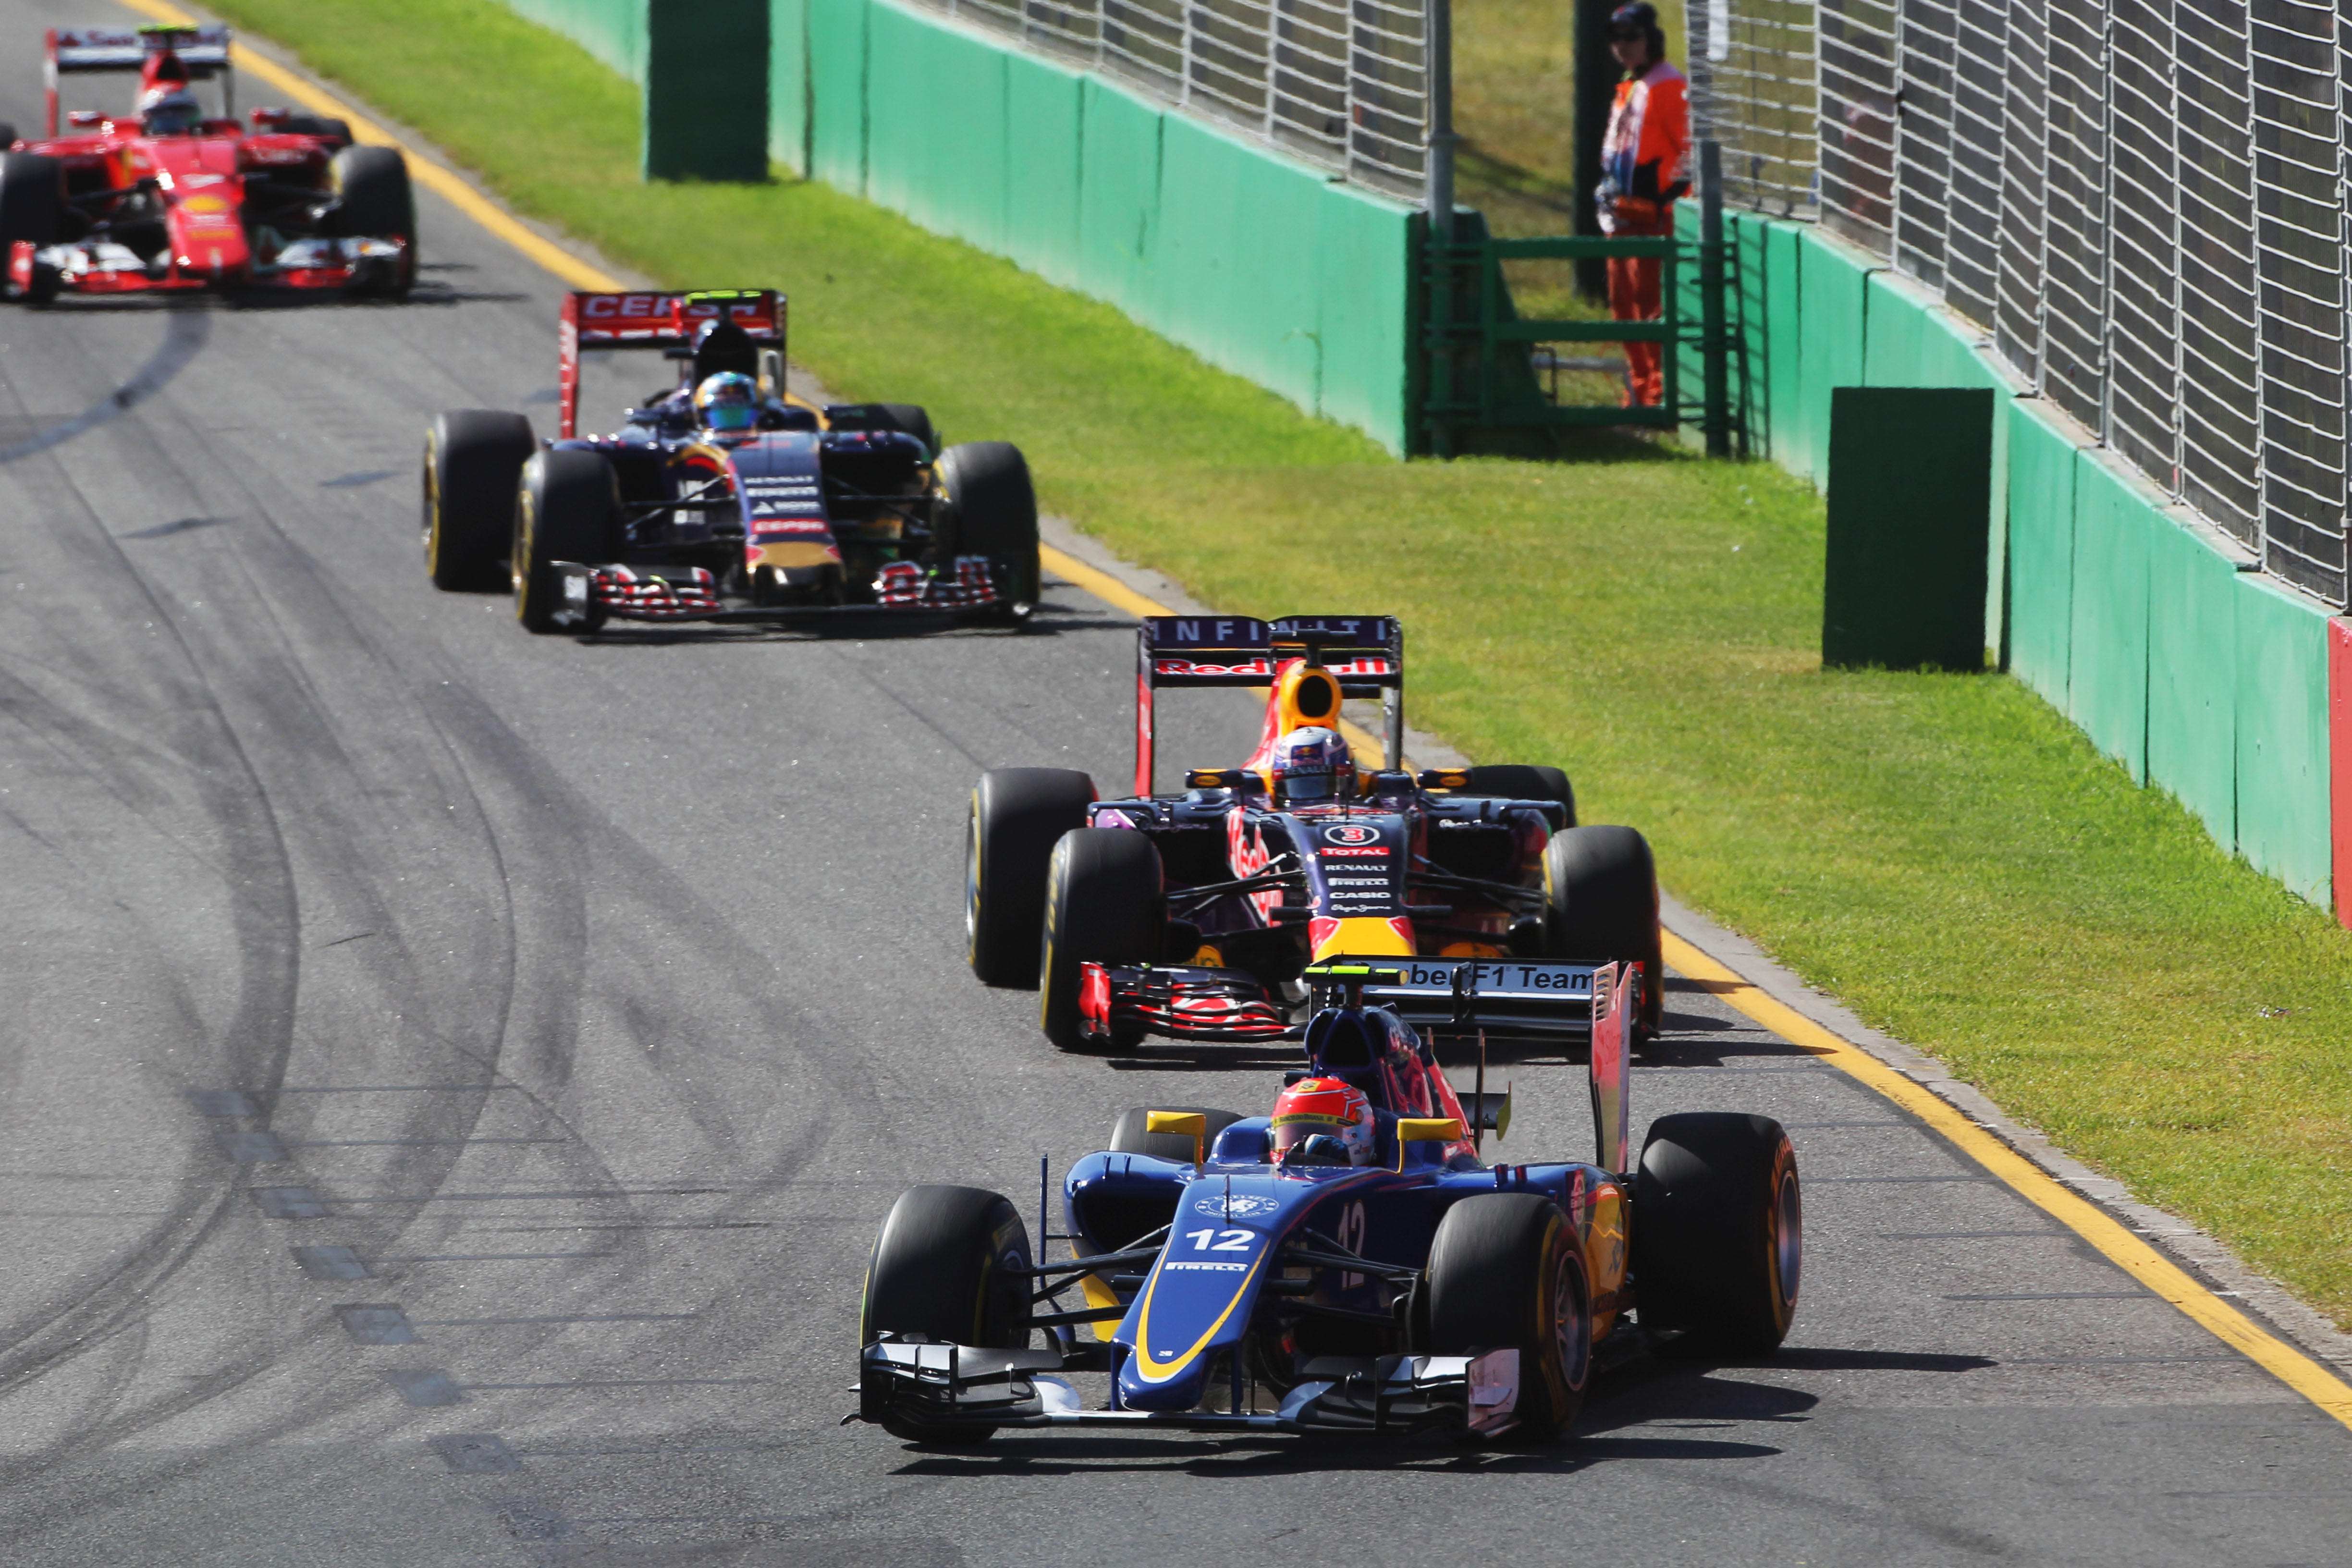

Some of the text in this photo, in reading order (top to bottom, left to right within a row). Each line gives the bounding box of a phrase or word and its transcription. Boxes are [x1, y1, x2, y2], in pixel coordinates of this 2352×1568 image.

[1154, 658, 1271, 675] Red
[1341, 828, 1365, 841] 3
[1322, 847, 1388, 856] TOTAL
[1471, 965, 1504, 986] F1
[1518, 967, 1593, 989] Team
[1186, 1228, 1255, 1251] 12
[1338, 1200, 1365, 1290] 12
[1165, 1262, 1249, 1272] PIRELLI
